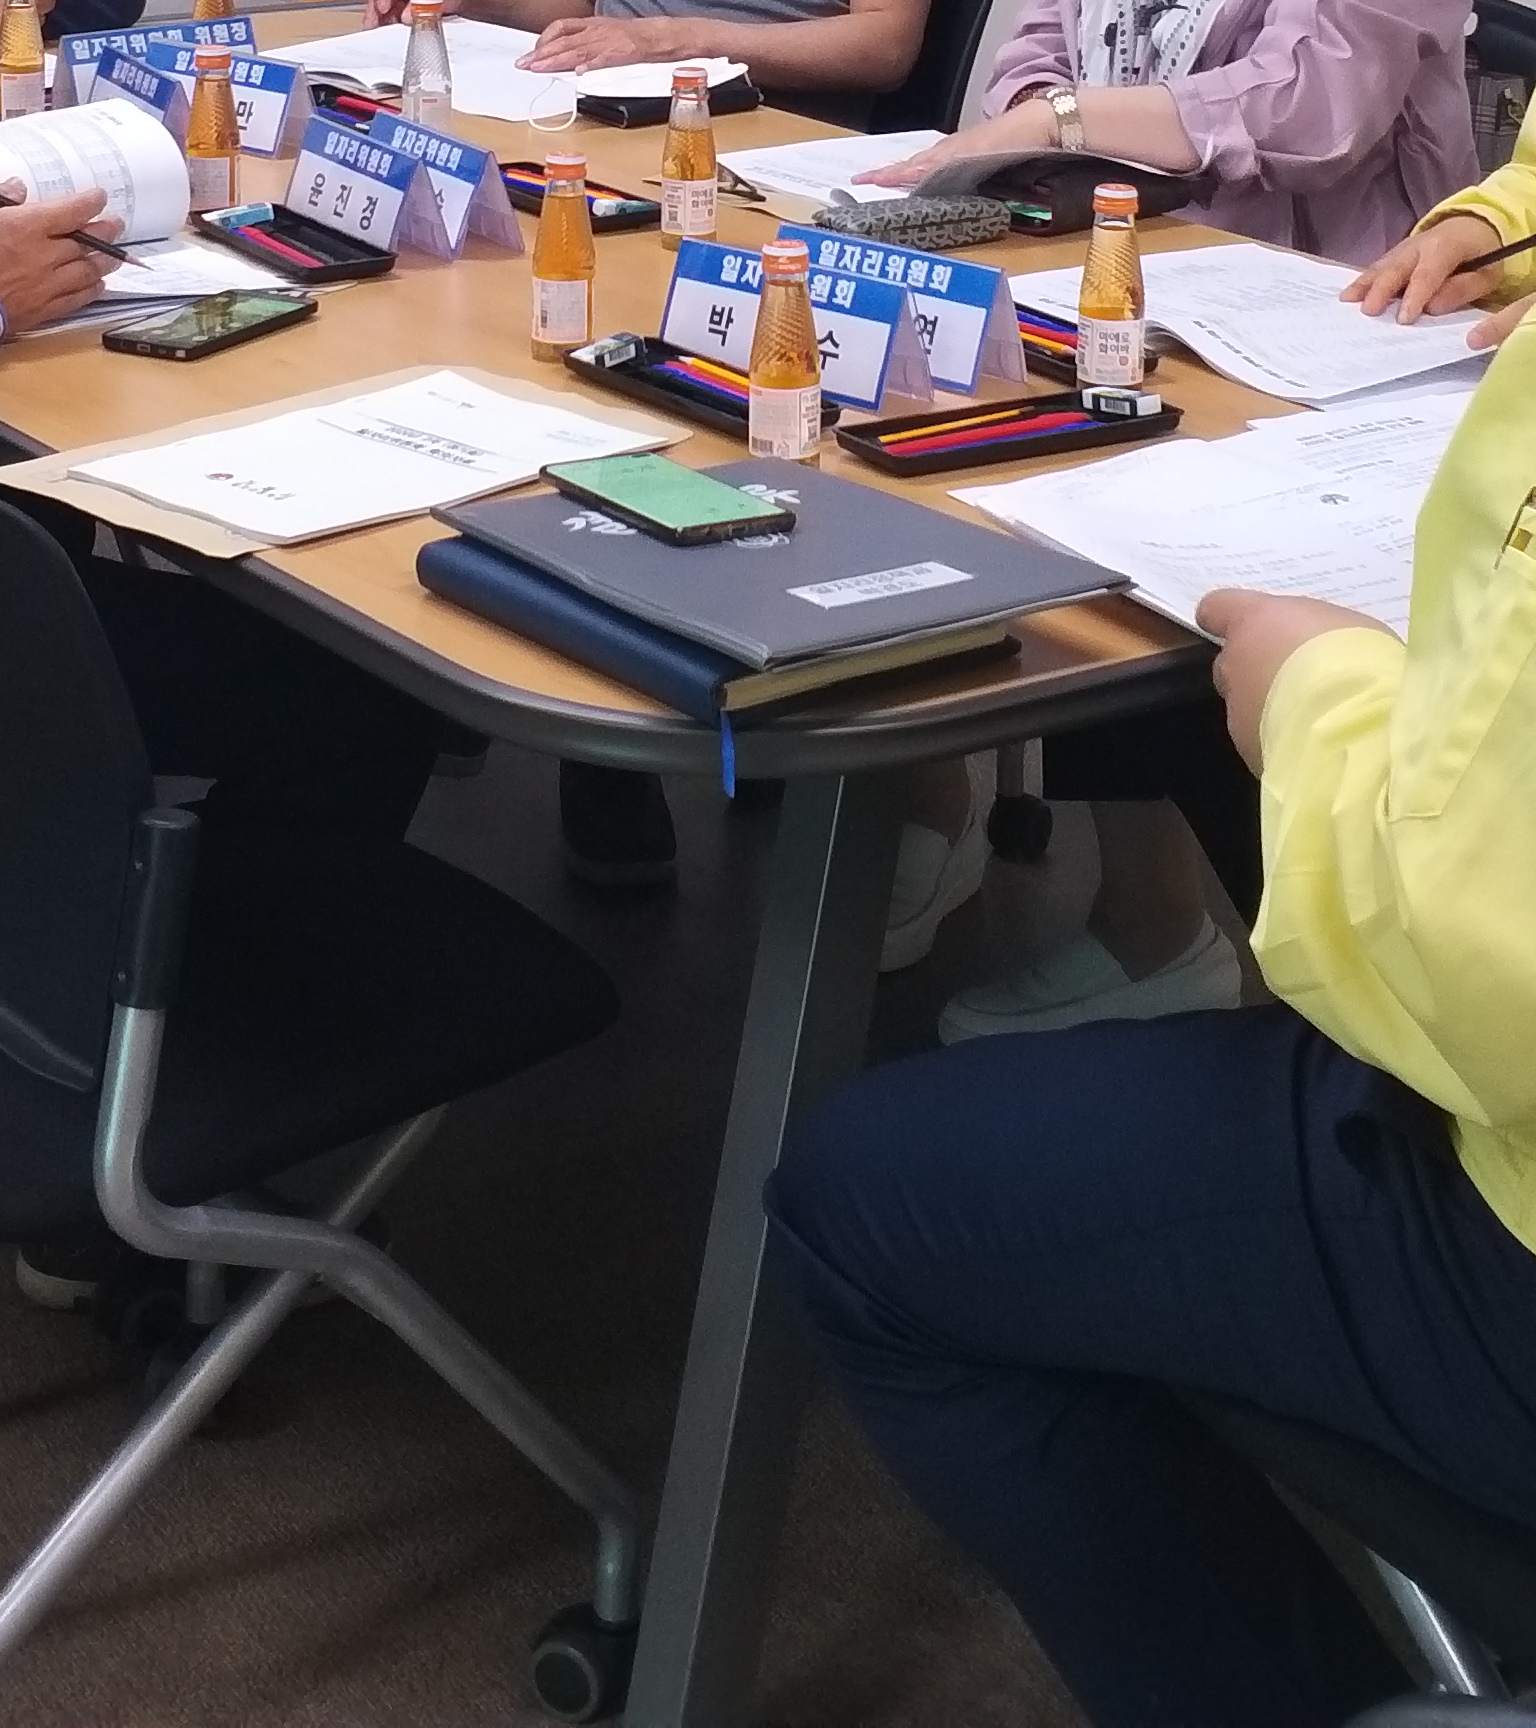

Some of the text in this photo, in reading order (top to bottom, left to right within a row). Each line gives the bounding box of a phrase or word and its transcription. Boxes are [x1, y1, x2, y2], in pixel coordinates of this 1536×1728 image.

[195, 22, 247, 46] 위원장
[324, 131, 393, 177] 일자리위원회
[392, 125, 463, 171] 일자리위원회
[720, 254, 856, 309] 일자원회
[820, 240, 952, 294] 일자리위원회
